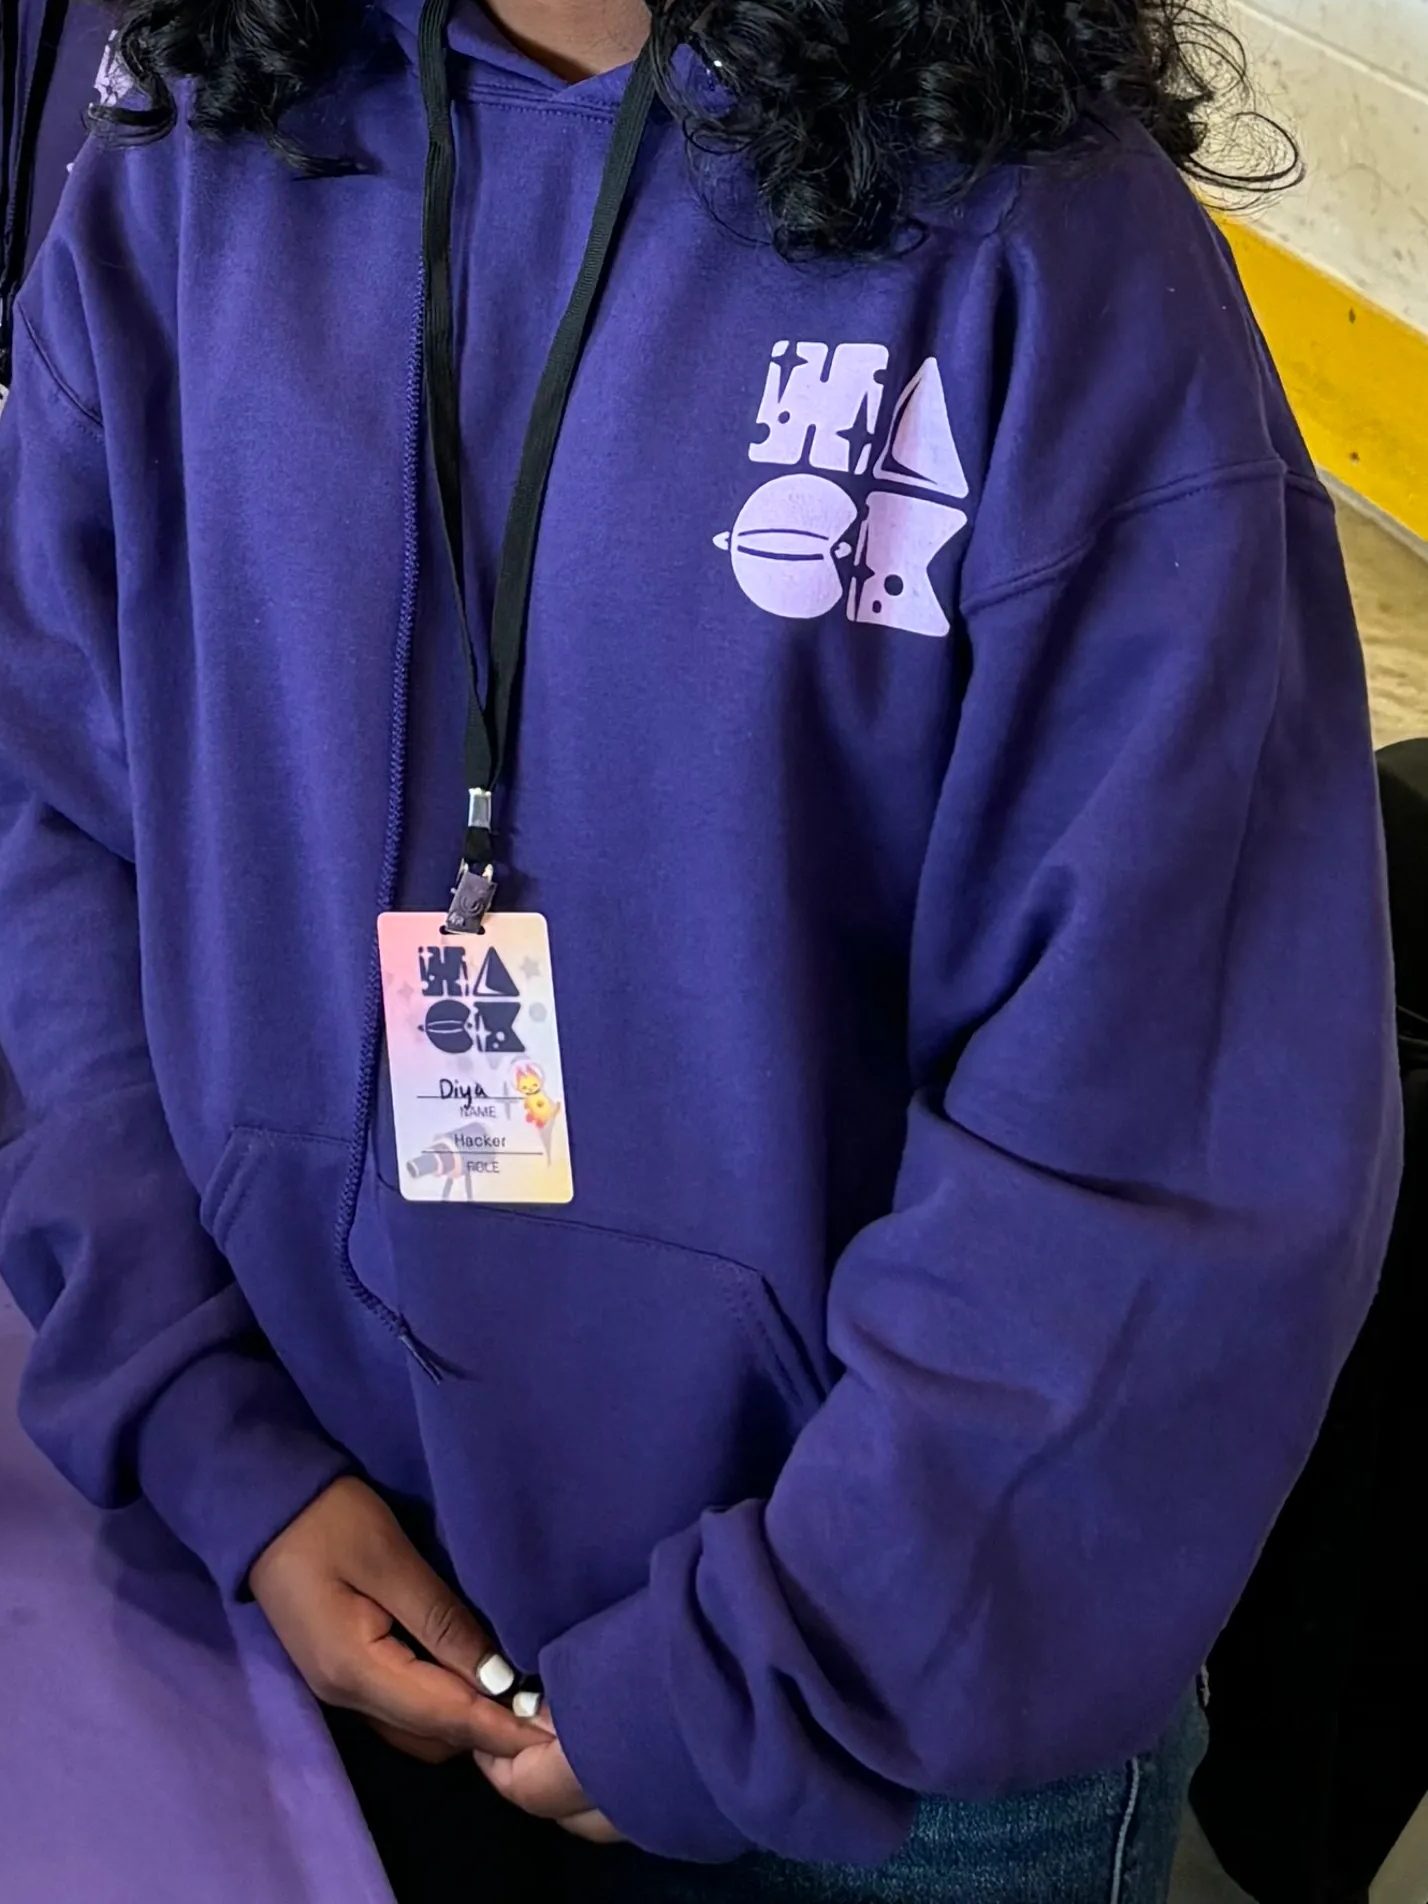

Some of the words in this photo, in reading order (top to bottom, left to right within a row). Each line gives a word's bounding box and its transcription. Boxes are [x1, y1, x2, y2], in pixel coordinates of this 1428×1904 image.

[438, 1077, 490, 1109] Diya
[459, 1105, 497, 1119] NAME
[454, 1133, 507, 1149] Hacker
